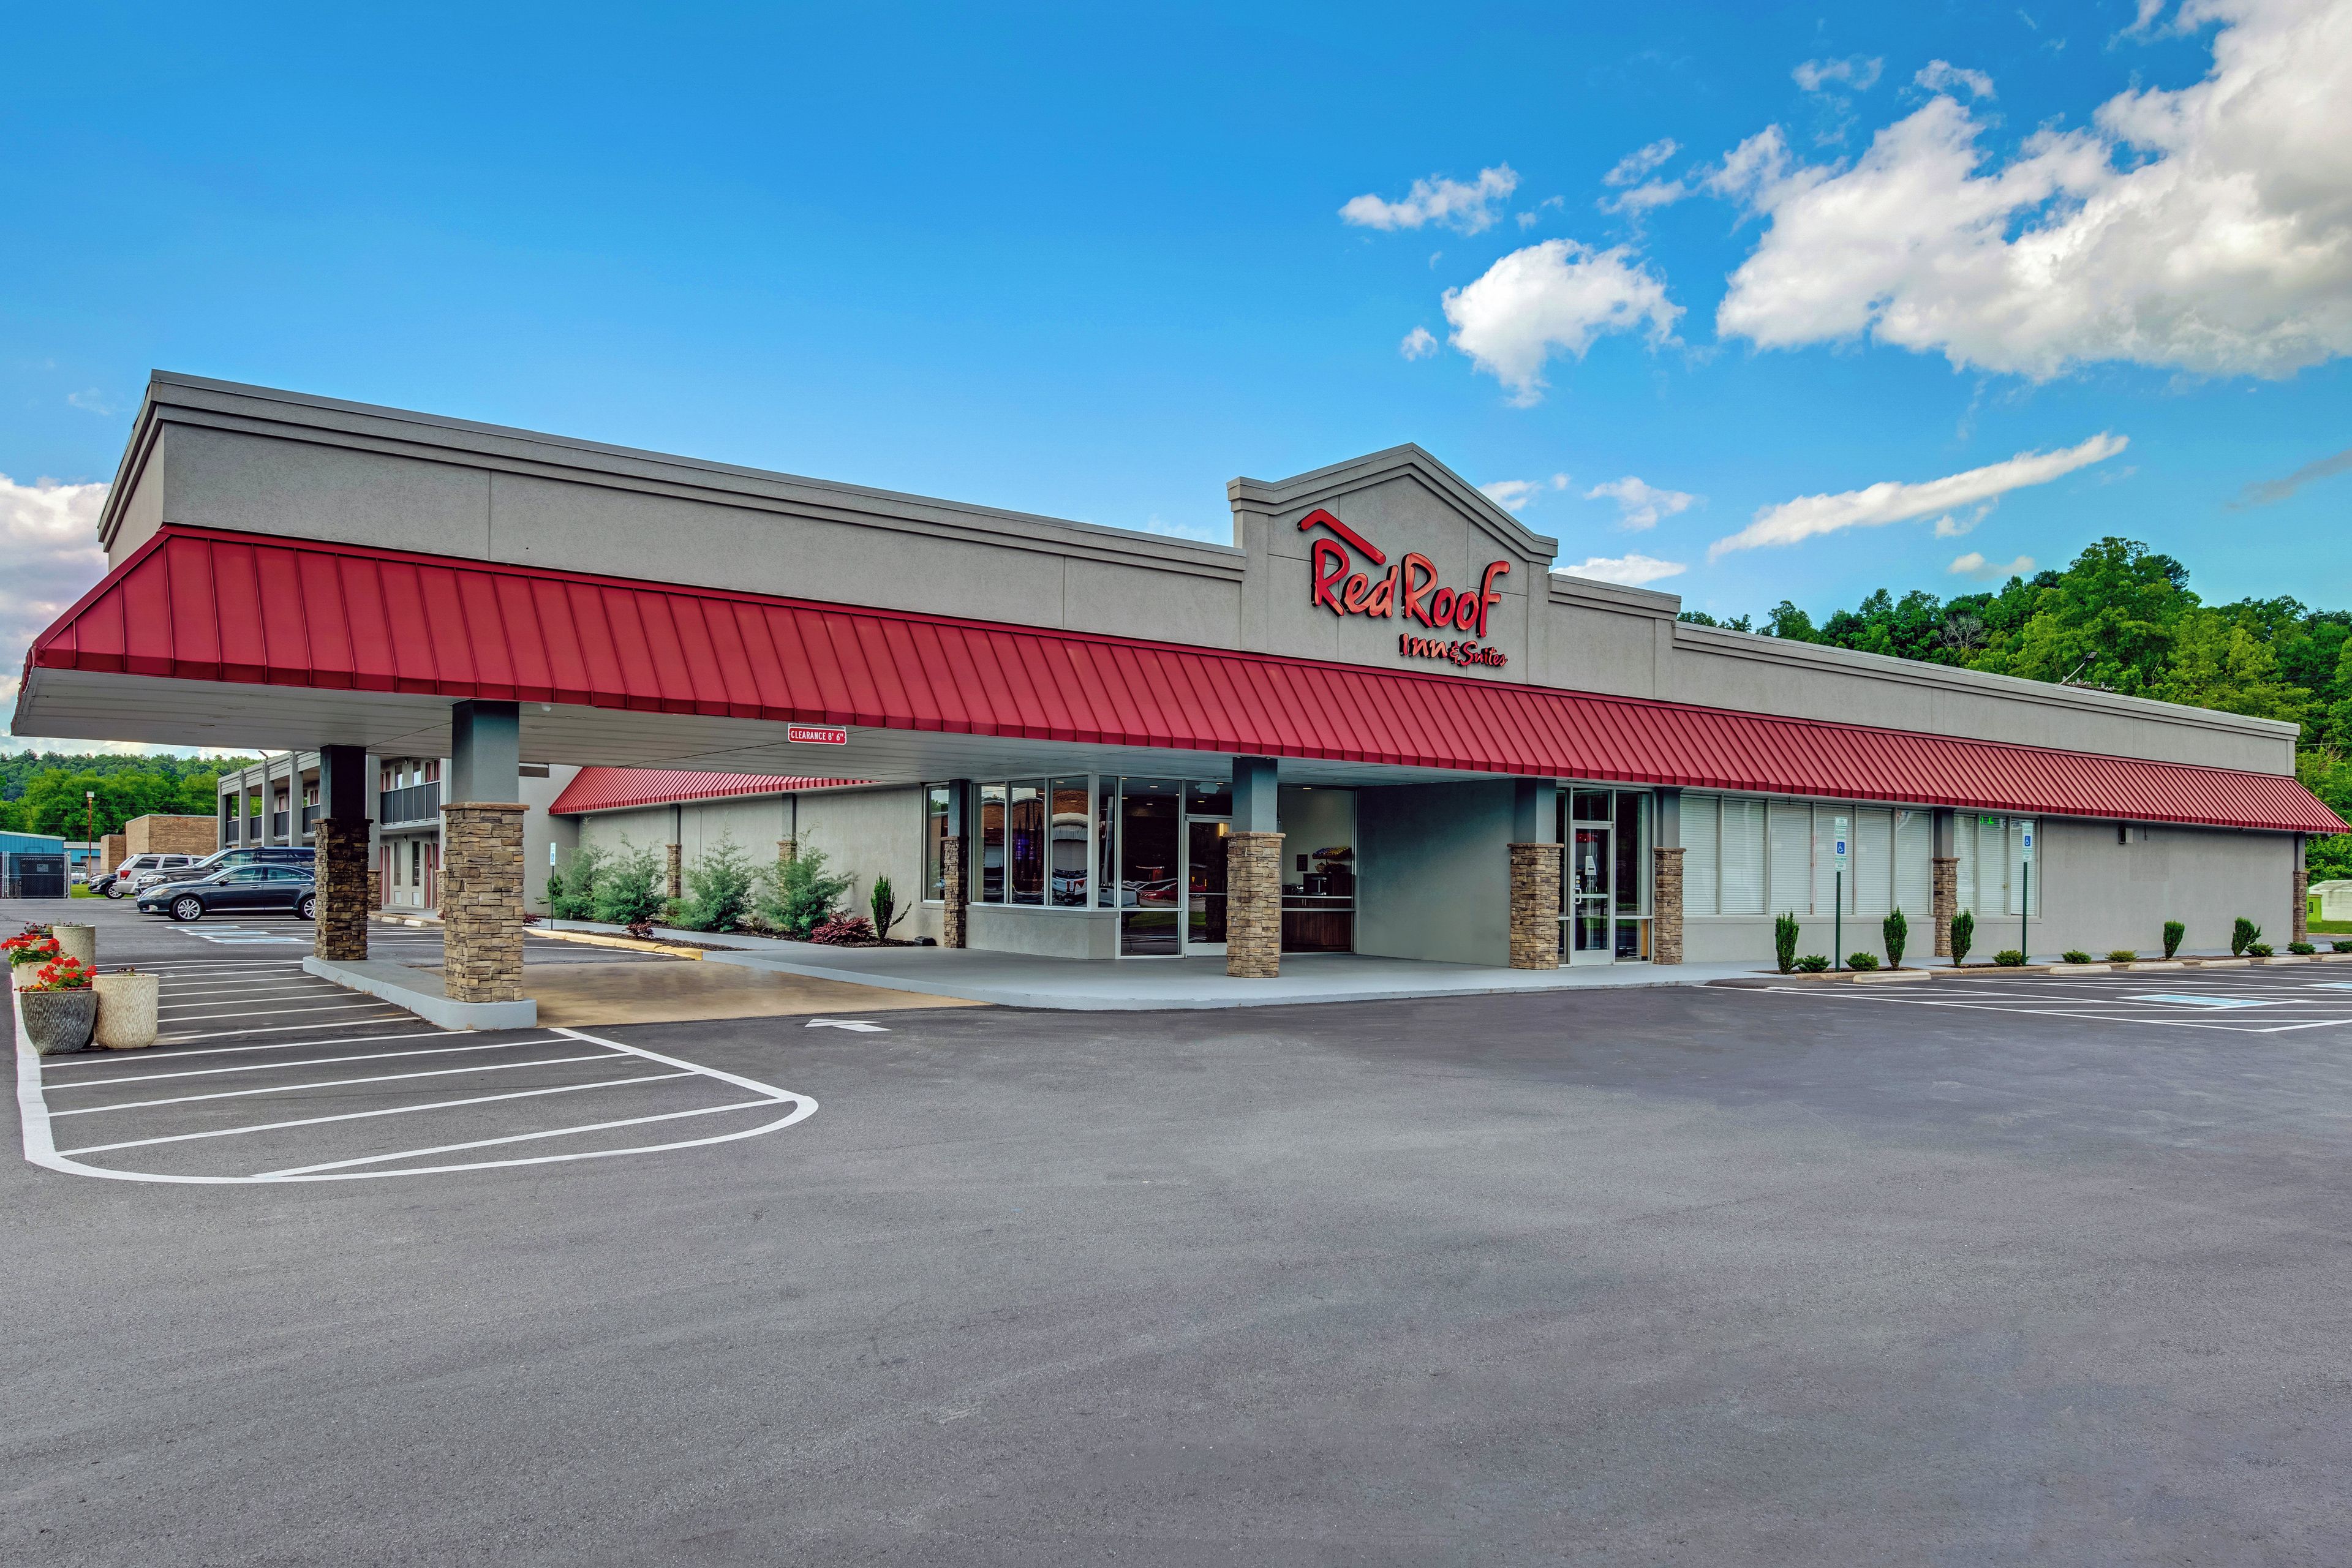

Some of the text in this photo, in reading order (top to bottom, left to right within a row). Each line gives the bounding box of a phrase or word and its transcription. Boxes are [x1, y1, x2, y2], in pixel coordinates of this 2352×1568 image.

[1311, 538, 1510, 638] Red Roof
[1399, 633, 1447, 658] Inn
[1460, 640, 1508, 666] Suites
[791, 730, 843, 741] CLEARANCE 8' 6"
